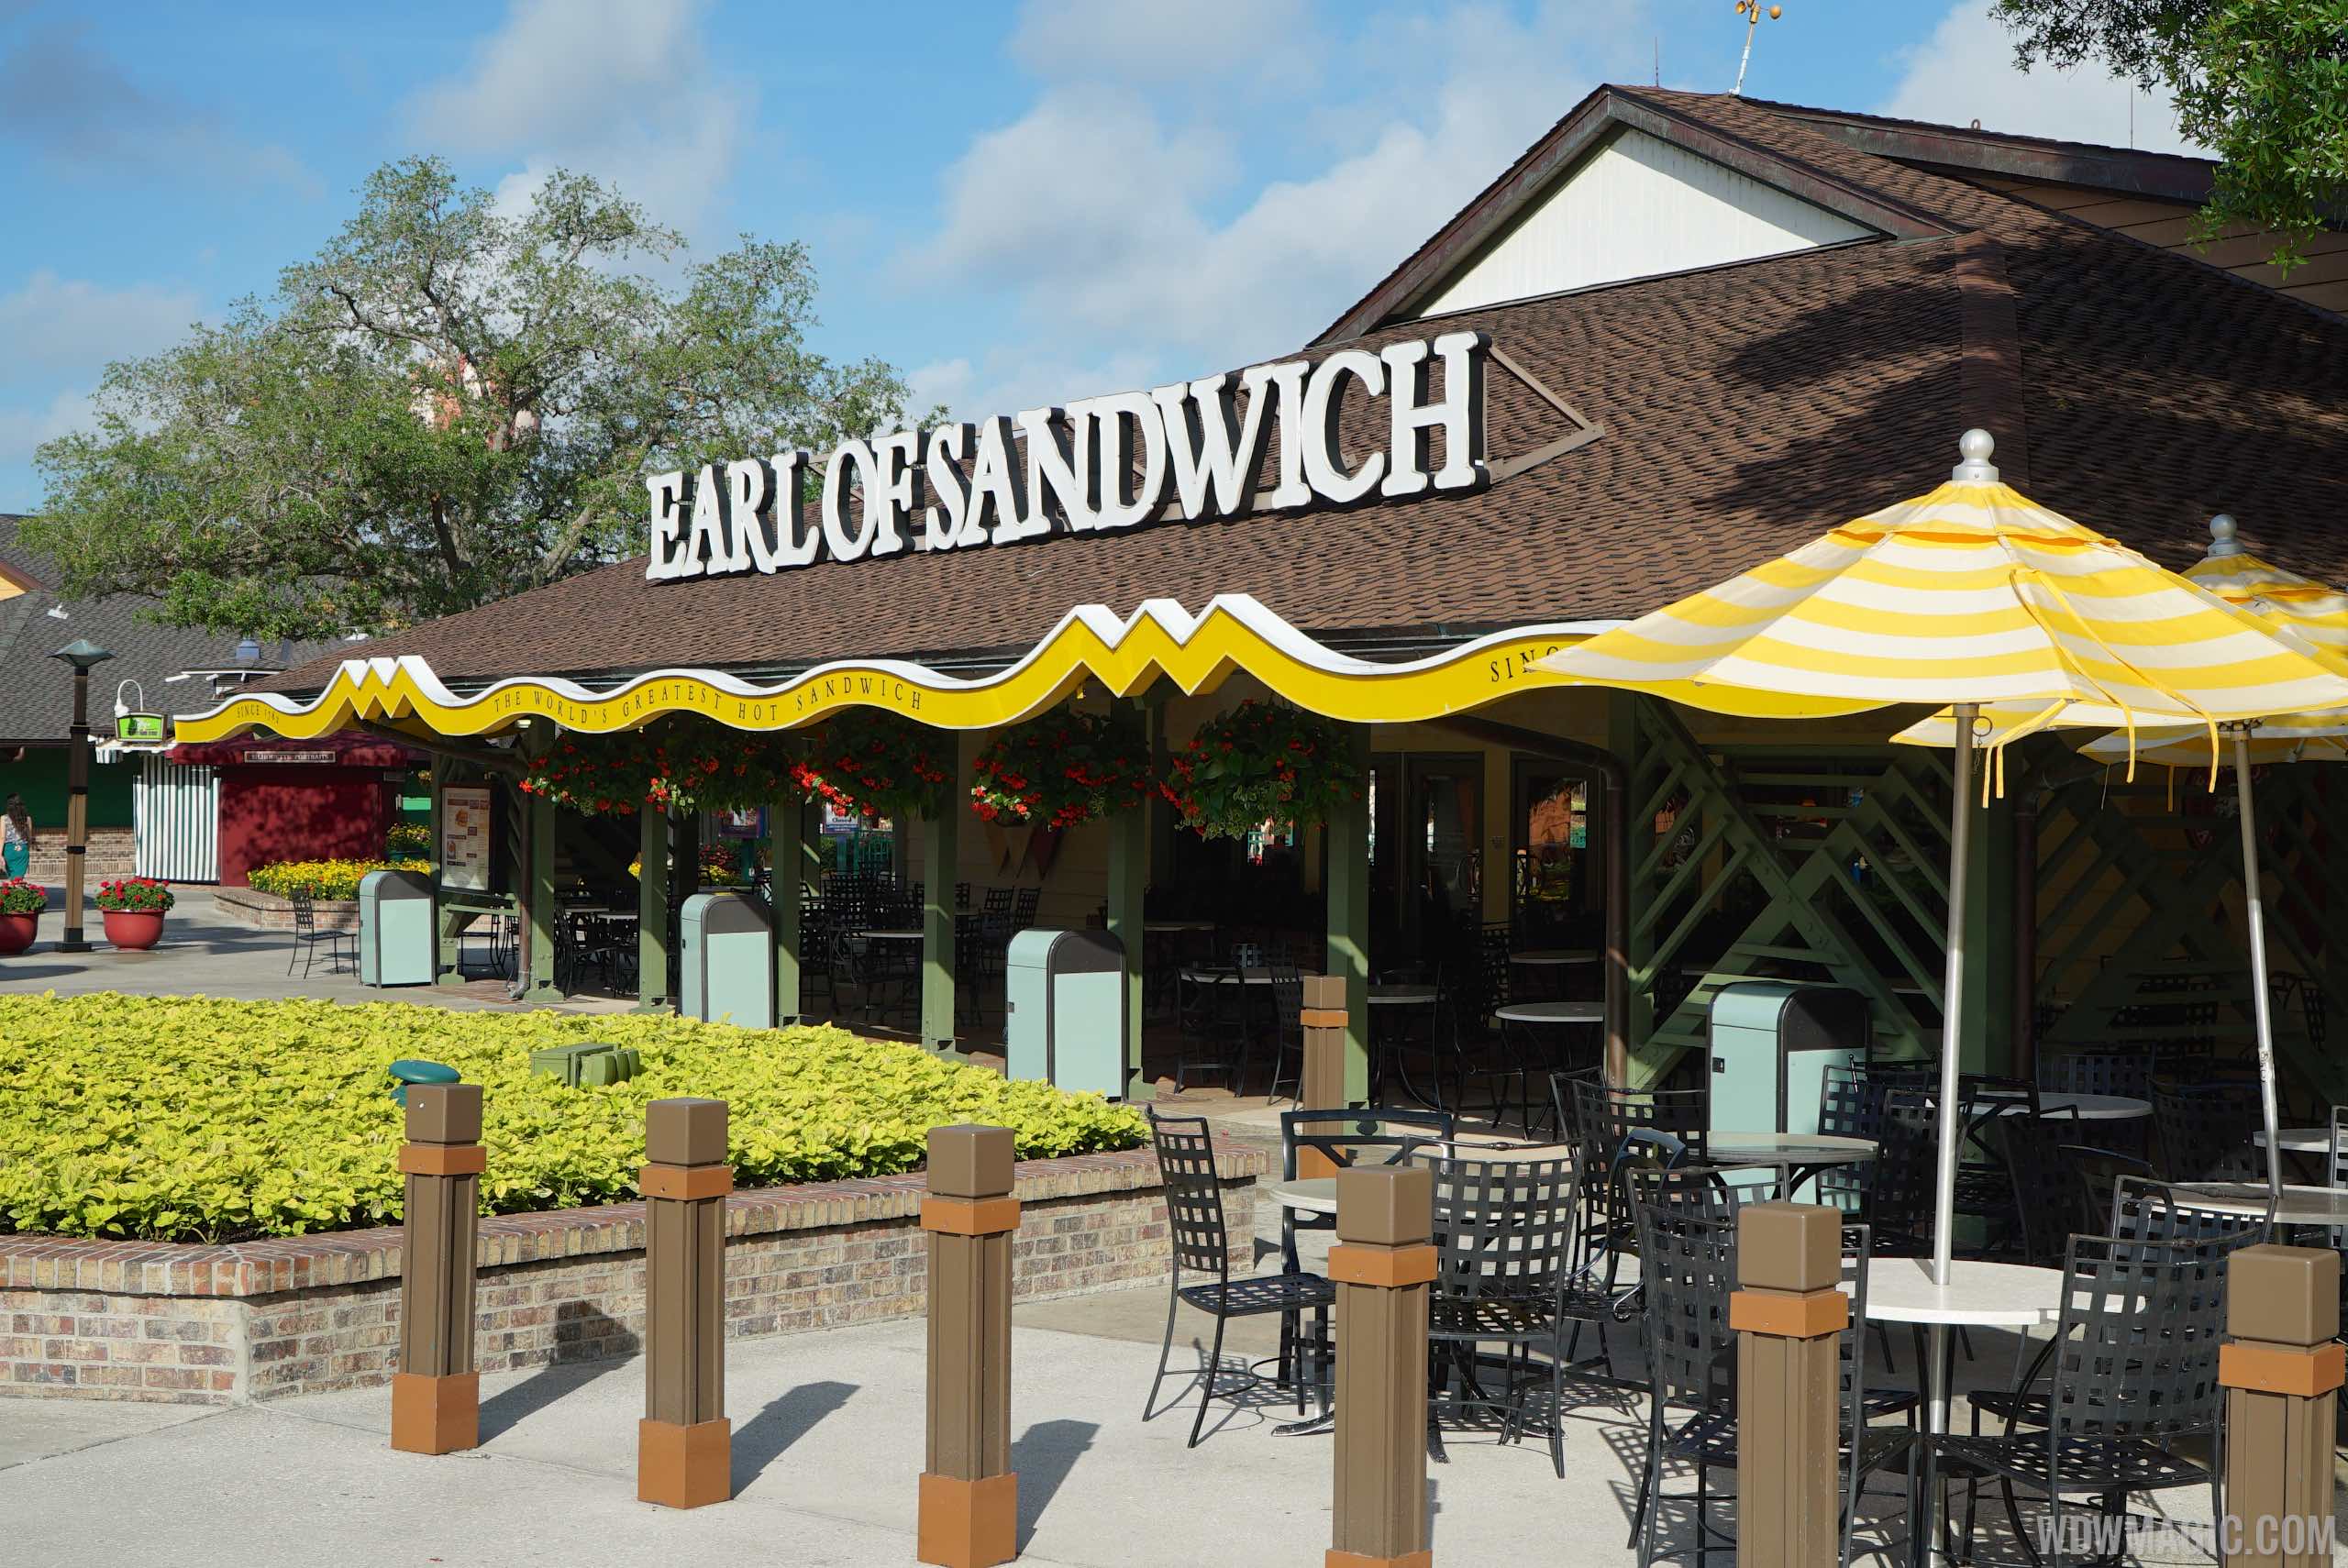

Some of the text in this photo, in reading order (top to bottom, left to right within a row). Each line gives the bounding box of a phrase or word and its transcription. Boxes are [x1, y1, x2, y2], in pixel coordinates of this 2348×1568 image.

[646, 330, 1481, 580] EARL OF SANDWICH
[493, 677, 921, 723] THE WORLD'S GREATEST HOT SANDWICH
